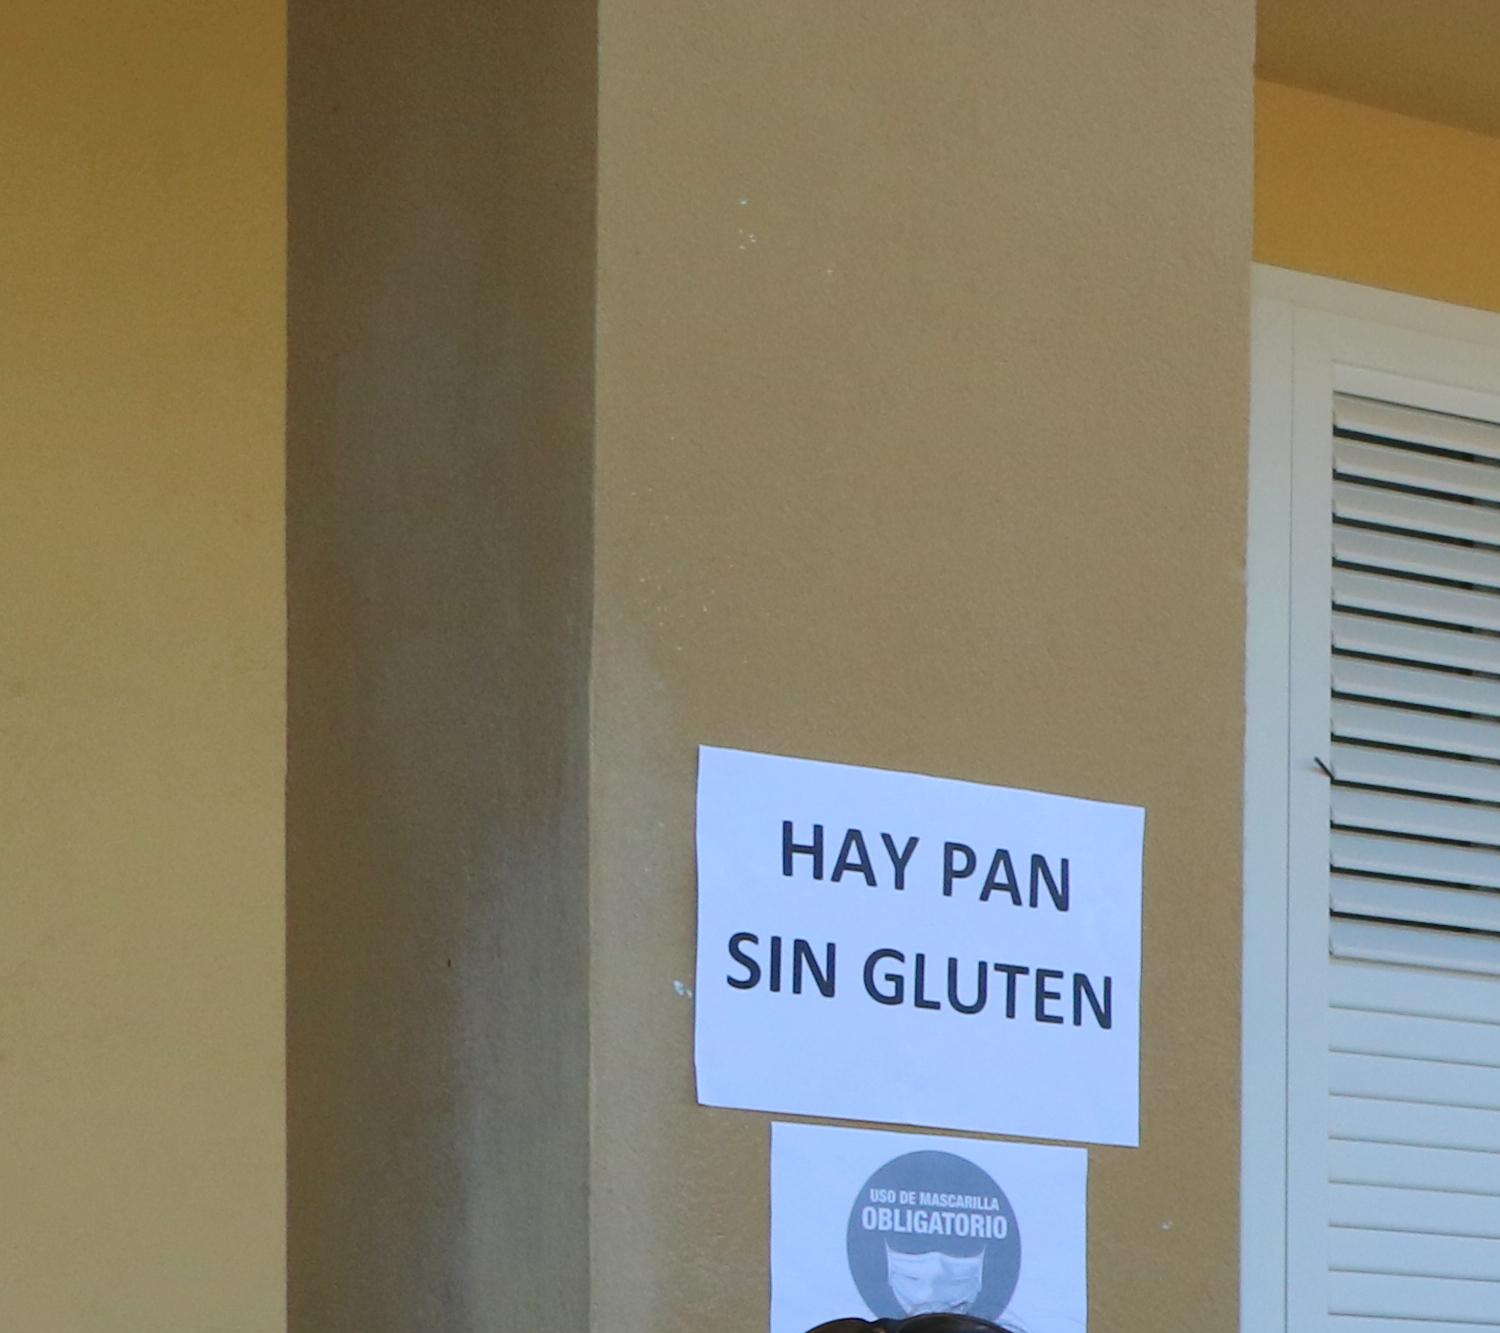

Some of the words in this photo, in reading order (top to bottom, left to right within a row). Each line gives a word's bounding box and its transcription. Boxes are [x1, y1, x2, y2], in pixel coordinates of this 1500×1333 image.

[782, 821, 919, 890] HAY
[943, 842, 1070, 911] PAN
[727, 932, 836, 998] SIN
[862, 947, 1113, 1029] GLUTEN
[862, 1206, 1008, 1239] OBLIGATORIO
[870, 1189, 895, 1203] USO
[900, 1191, 916, 1205] DE
[919, 1192, 1000, 1211] MASCARILLA
